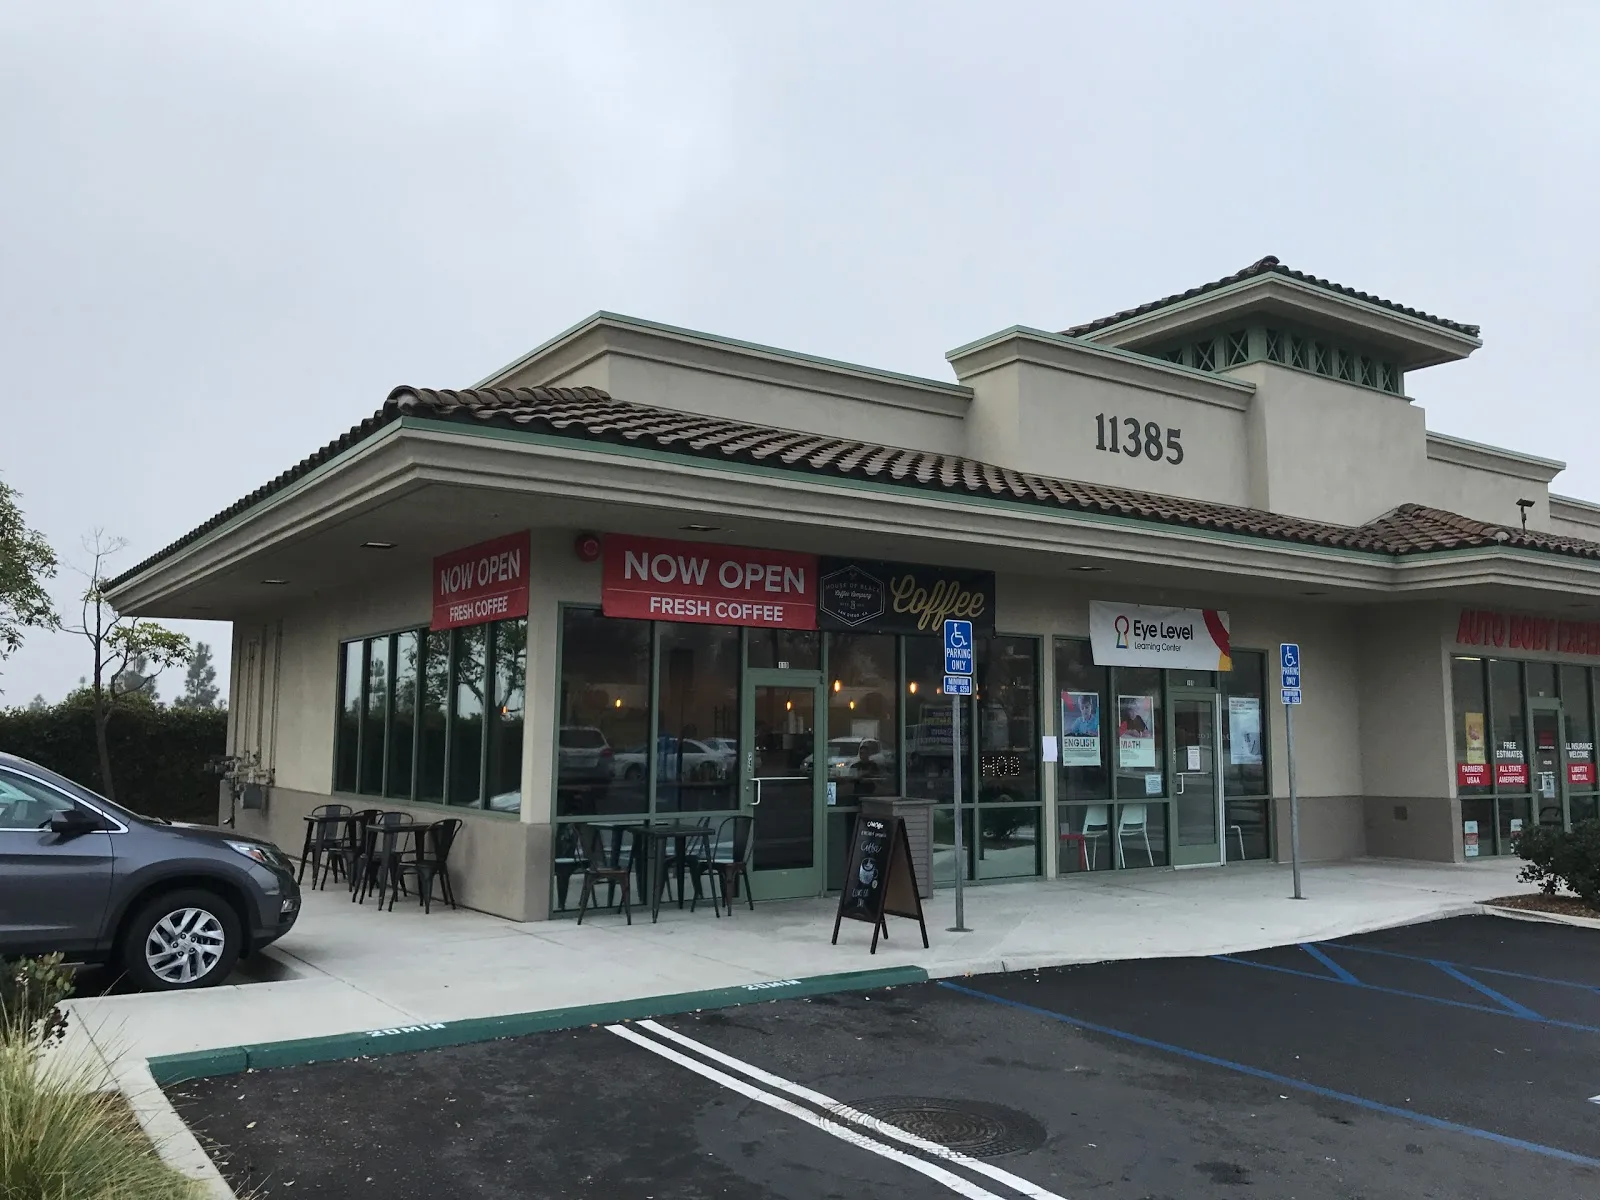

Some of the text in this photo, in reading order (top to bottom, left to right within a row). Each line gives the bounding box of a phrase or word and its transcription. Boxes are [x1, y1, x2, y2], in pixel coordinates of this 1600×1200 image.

[1095, 412, 1184, 466] 11385
[440, 548, 520, 596] NOW OPEN
[624, 550, 805, 594] NOW OPEN
[890, 574, 985, 632] Coffee
[449, 596, 509, 622] FRESH COFFEE
[650, 596, 784, 622] FRESH COFFEE
[1133, 619, 1194, 641] Eye Level
[1456, 607, 1505, 648] AUTO
[1508, 614, 1556, 651] BODY
[1134, 642, 1182, 652] Learning Center
[946, 647, 971, 659] PARKING
[951, 659, 966, 671] ONLY
[947, 677, 969, 686] MINIMUM
[946, 684, 957, 692] FINE
[1064, 738, 1095, 748] ENGLISH
[1120, 740, 1141, 749] MATH
[1503, 741, 1517, 750] FREE
[1571, 742, 1593, 750] INSURANCE
[1496, 750, 1524, 758] ESTIMATES
[1568, 750, 1589, 759] WELCOME
[981, 755, 1020, 777] HOB
[1461, 765, 1484, 773] FARMERS
[1499, 765, 1522, 773] ALL STATE
[1571, 765, 1588, 773] LIBERTY
[1466, 776, 1481, 784] USAA
[1571, 773, 1588, 781] MUTUAL
